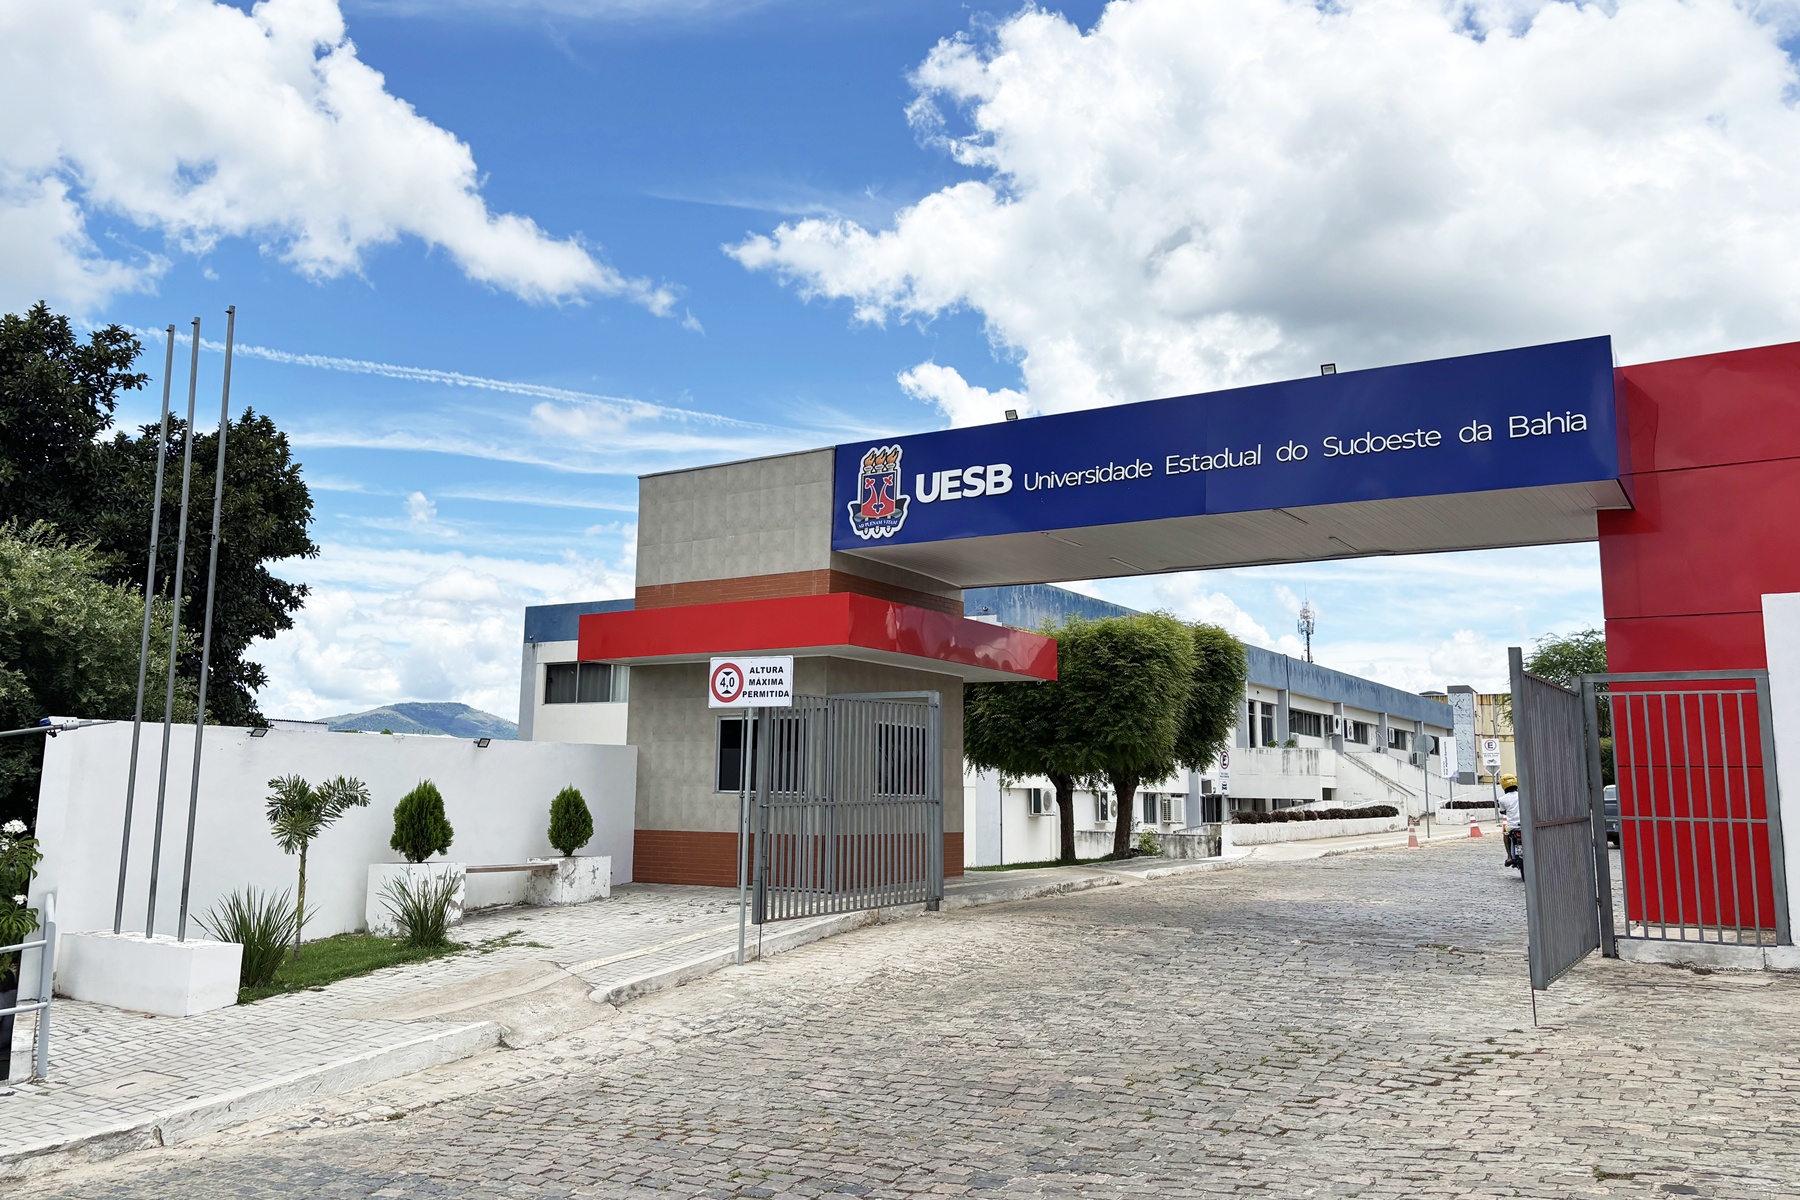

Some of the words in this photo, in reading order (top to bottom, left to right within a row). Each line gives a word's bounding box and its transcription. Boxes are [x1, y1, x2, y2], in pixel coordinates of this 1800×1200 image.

[1024, 458, 1154, 492] Universidade
[1165, 443, 1263, 475] Estadual
[1276, 440, 1309, 462] do
[1323, 431, 1442, 458] Sudoeste
[1458, 420, 1493, 443] da
[1509, 410, 1588, 438] Bahia
[916, 463, 1013, 503] UESB
[720, 677, 735, 689] 4,0
[748, 677, 784, 686] MÁXIMA
